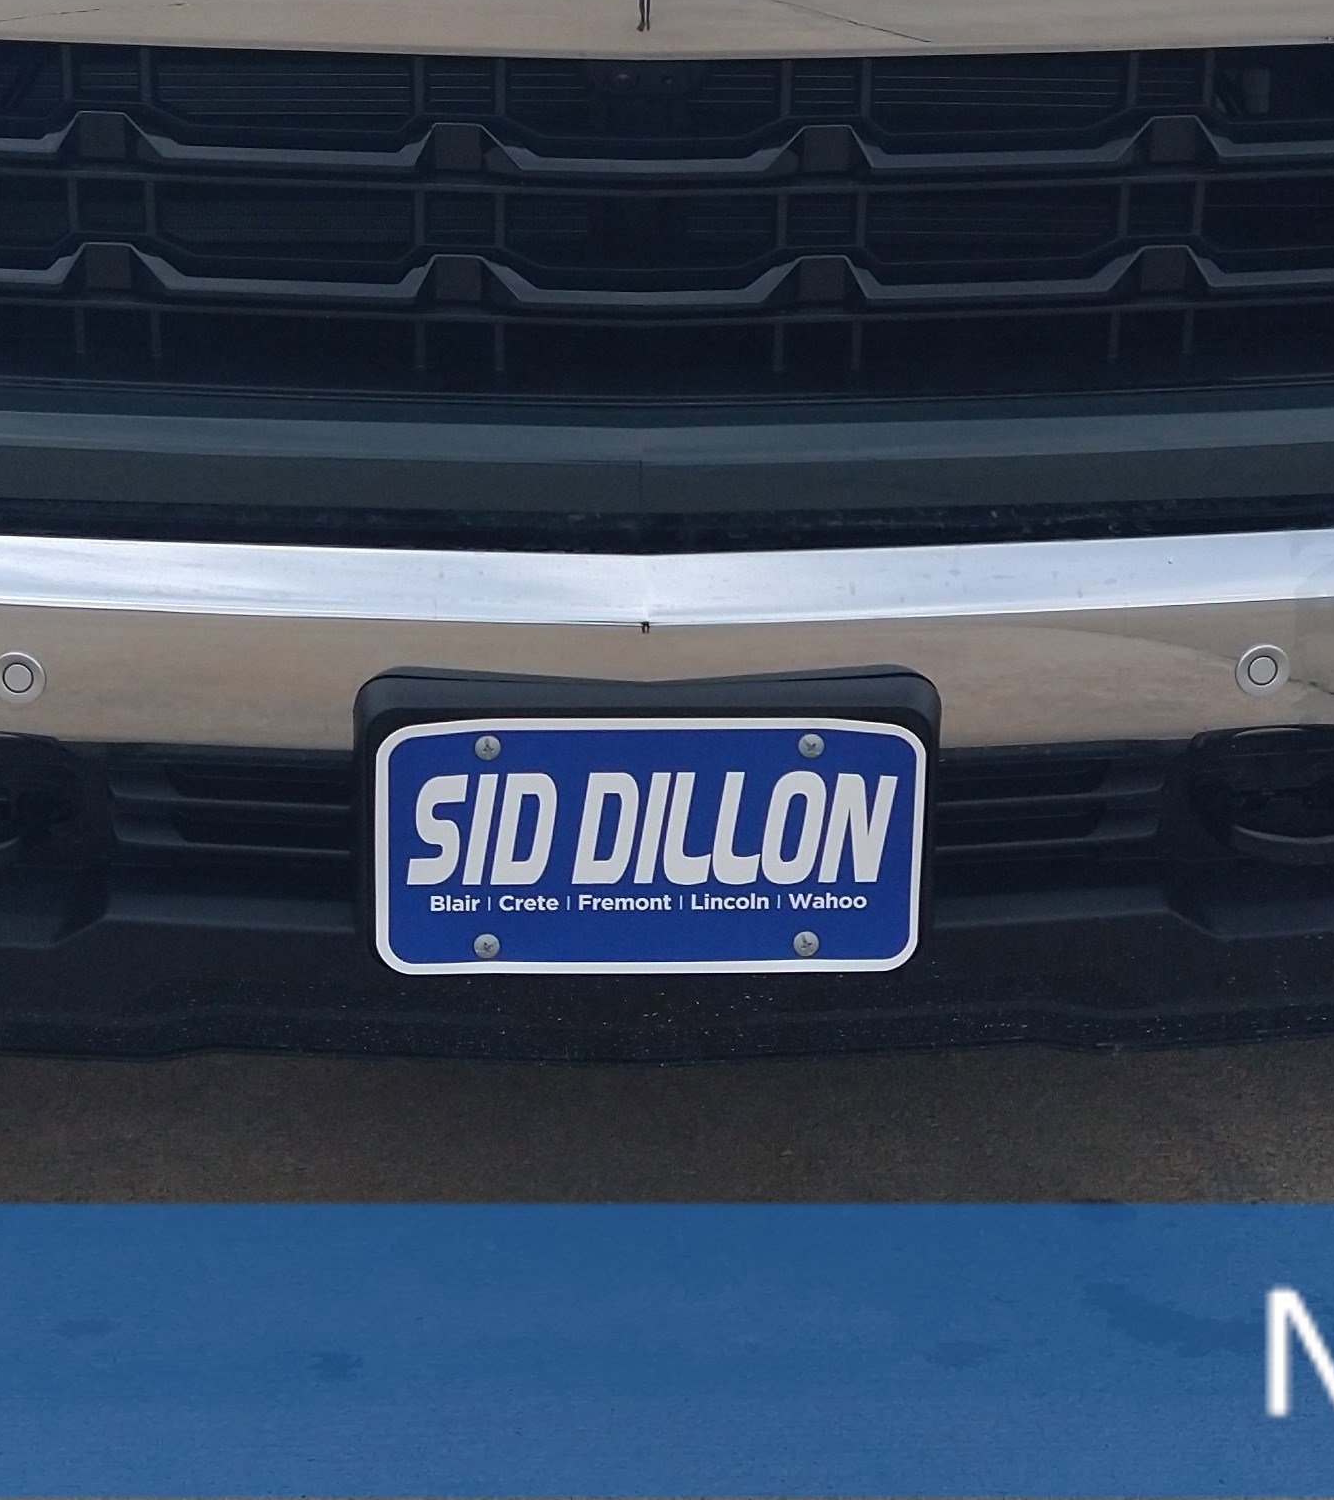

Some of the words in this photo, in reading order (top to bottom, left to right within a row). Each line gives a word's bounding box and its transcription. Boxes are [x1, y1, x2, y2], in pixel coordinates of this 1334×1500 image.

[406, 773, 558, 886] SID
[571, 770, 898, 886] DILLON
[430, 894, 481, 912] Blair
[499, 895, 559, 912] Crete
[578, 894, 672, 911] Fremont
[691, 892, 770, 910] Lincoln
[788, 892, 867, 910] Wahoo
